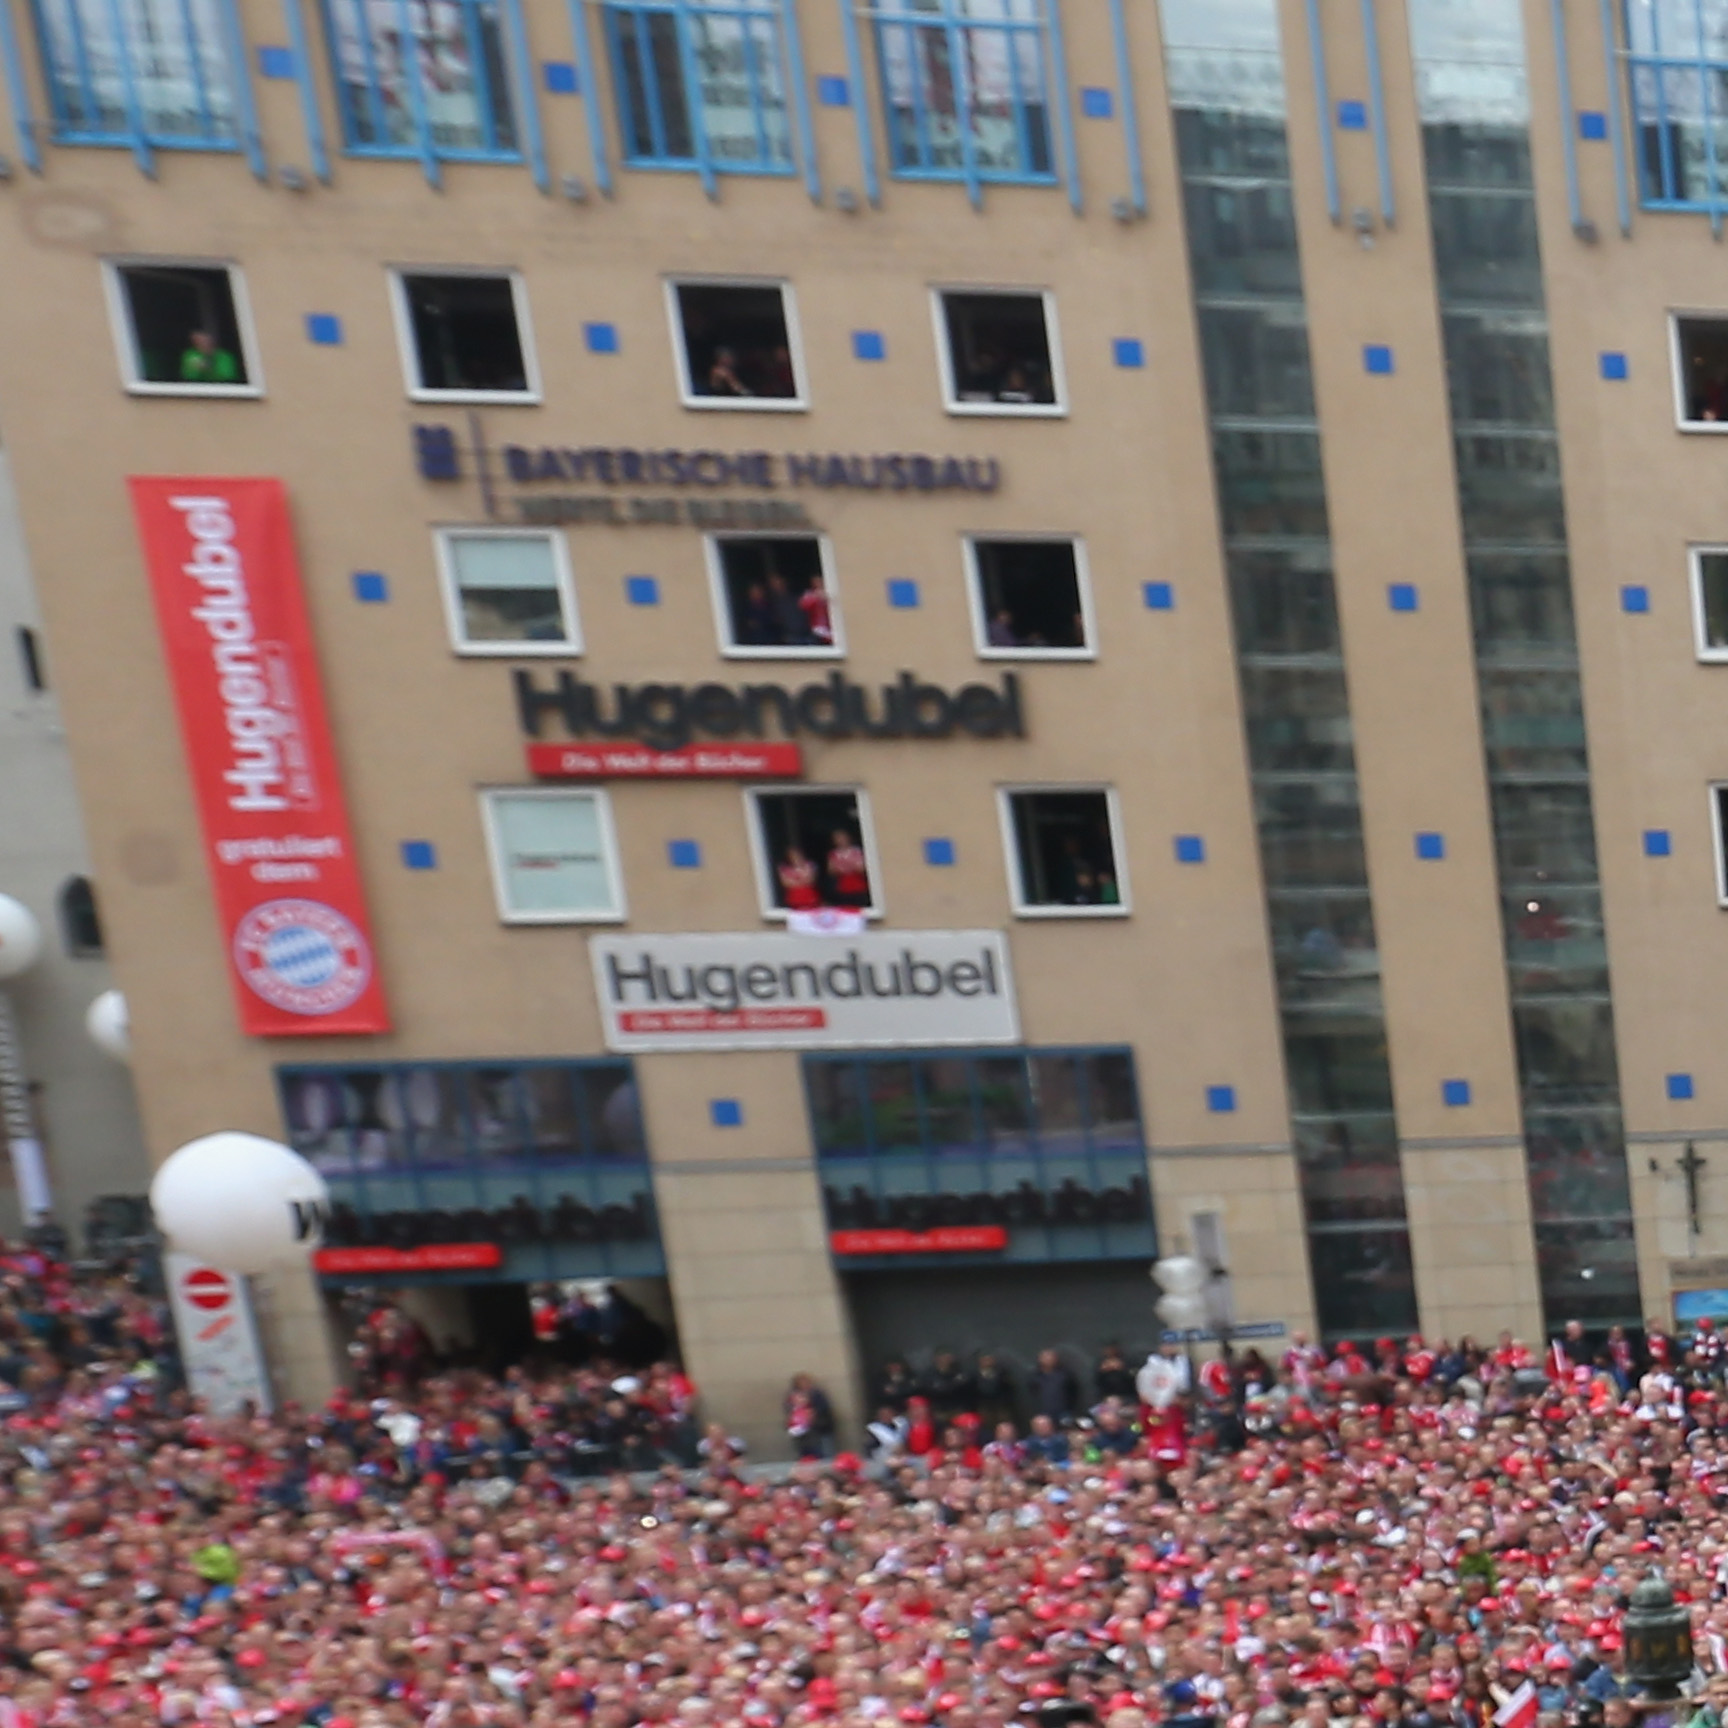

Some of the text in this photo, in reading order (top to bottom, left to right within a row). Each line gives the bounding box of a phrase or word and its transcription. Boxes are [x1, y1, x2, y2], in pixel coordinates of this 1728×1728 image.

[504, 445, 1000, 493] BAYERISCHE HAUSBAU
[169, 496, 290, 812] Hugendubel
[513, 667, 1028, 750] Hugendubel
[562, 752, 598, 771] Die
[606, 948, 999, 1013] Hugendubel
